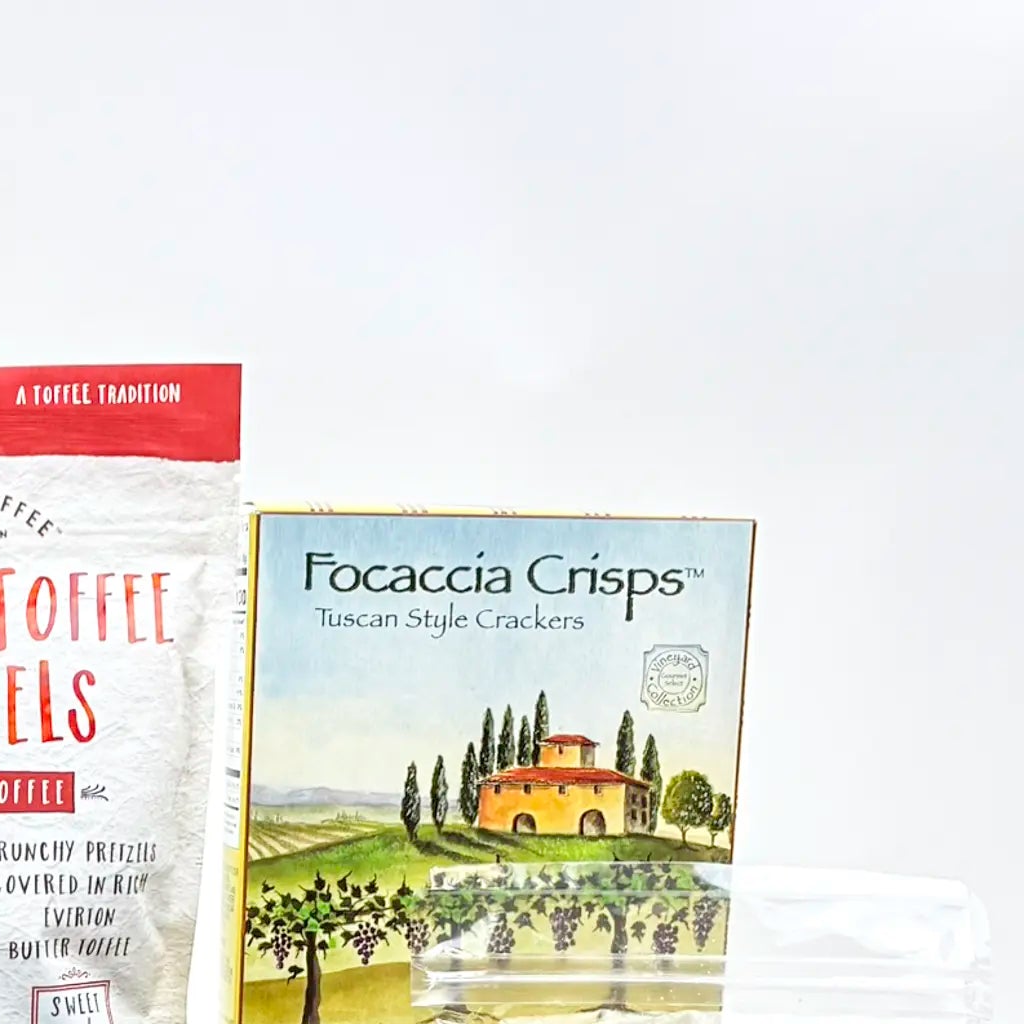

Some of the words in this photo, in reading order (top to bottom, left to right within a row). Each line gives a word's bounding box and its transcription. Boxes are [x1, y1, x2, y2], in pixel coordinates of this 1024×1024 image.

[15, 385, 27, 405] A
[33, 384, 92, 404] TOFFEE
[98, 383, 181, 404] TRADITION
[303, 550, 512, 596] Focaccia
[315, 606, 398, 630] Tuscan
[404, 606, 469, 639] Style
[475, 604, 585, 631] Crackers
[651, 654, 700, 671] Vineyard
[647, 683, 698, 707] Collection
[86, 839, 157, 862] PRETZELS
[87, 874, 106, 895] IN
[112, 872, 148, 895] RICH
[44, 907, 116, 928] EVERTON
[8, 938, 71, 960] BUTTER
[77, 936, 131, 957] TOFFEE
[50, 992, 102, 1018] SWEET
